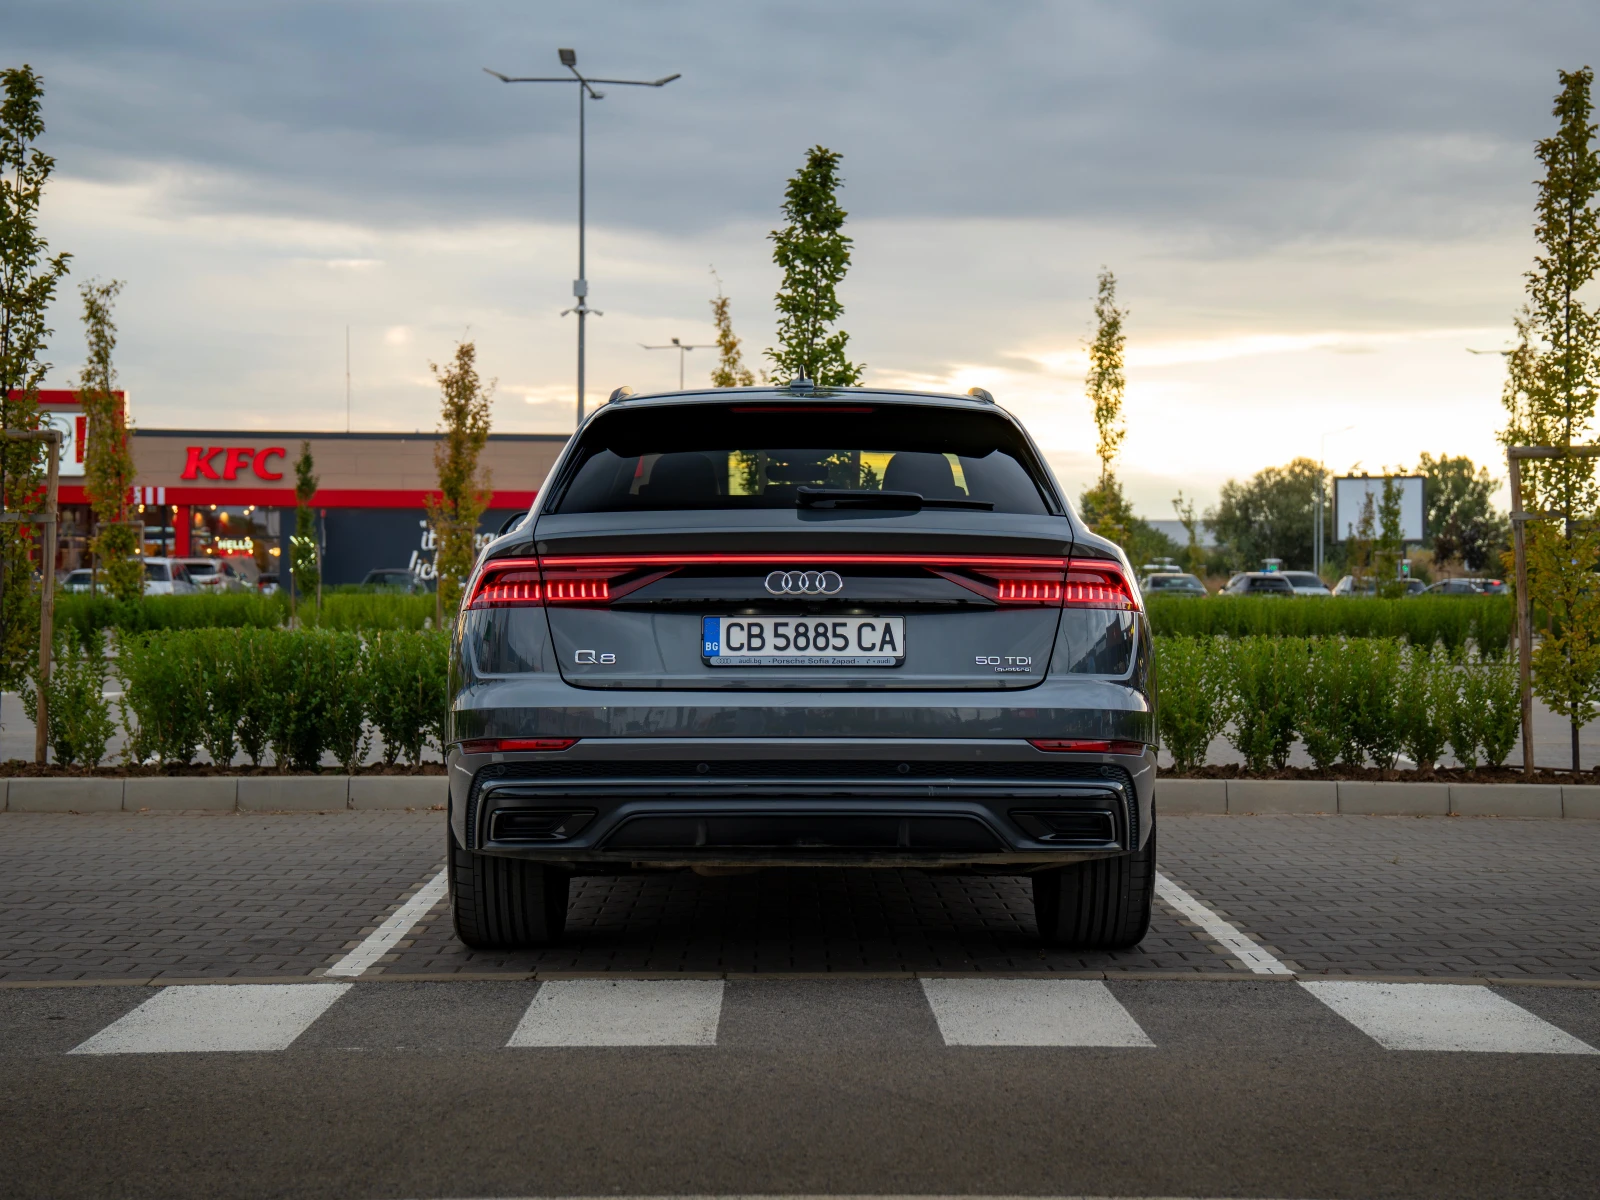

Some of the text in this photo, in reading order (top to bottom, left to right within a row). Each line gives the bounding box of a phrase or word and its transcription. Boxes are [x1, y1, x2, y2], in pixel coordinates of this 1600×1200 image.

[180, 447, 286, 480] KFC
[218, 540, 254, 550] HELLO
[726, 622, 897, 652] CB 5885 CA
[705, 642, 719, 651] BG
[575, 650, 616, 664] Q8
[738, 657, 762, 665] audi.bg
[772, 657, 806, 665] Porsche
[807, 657, 830, 665] Sofia
[831, 657, 856, 666] Zapad
[975, 656, 1032, 665] 50 TDI
